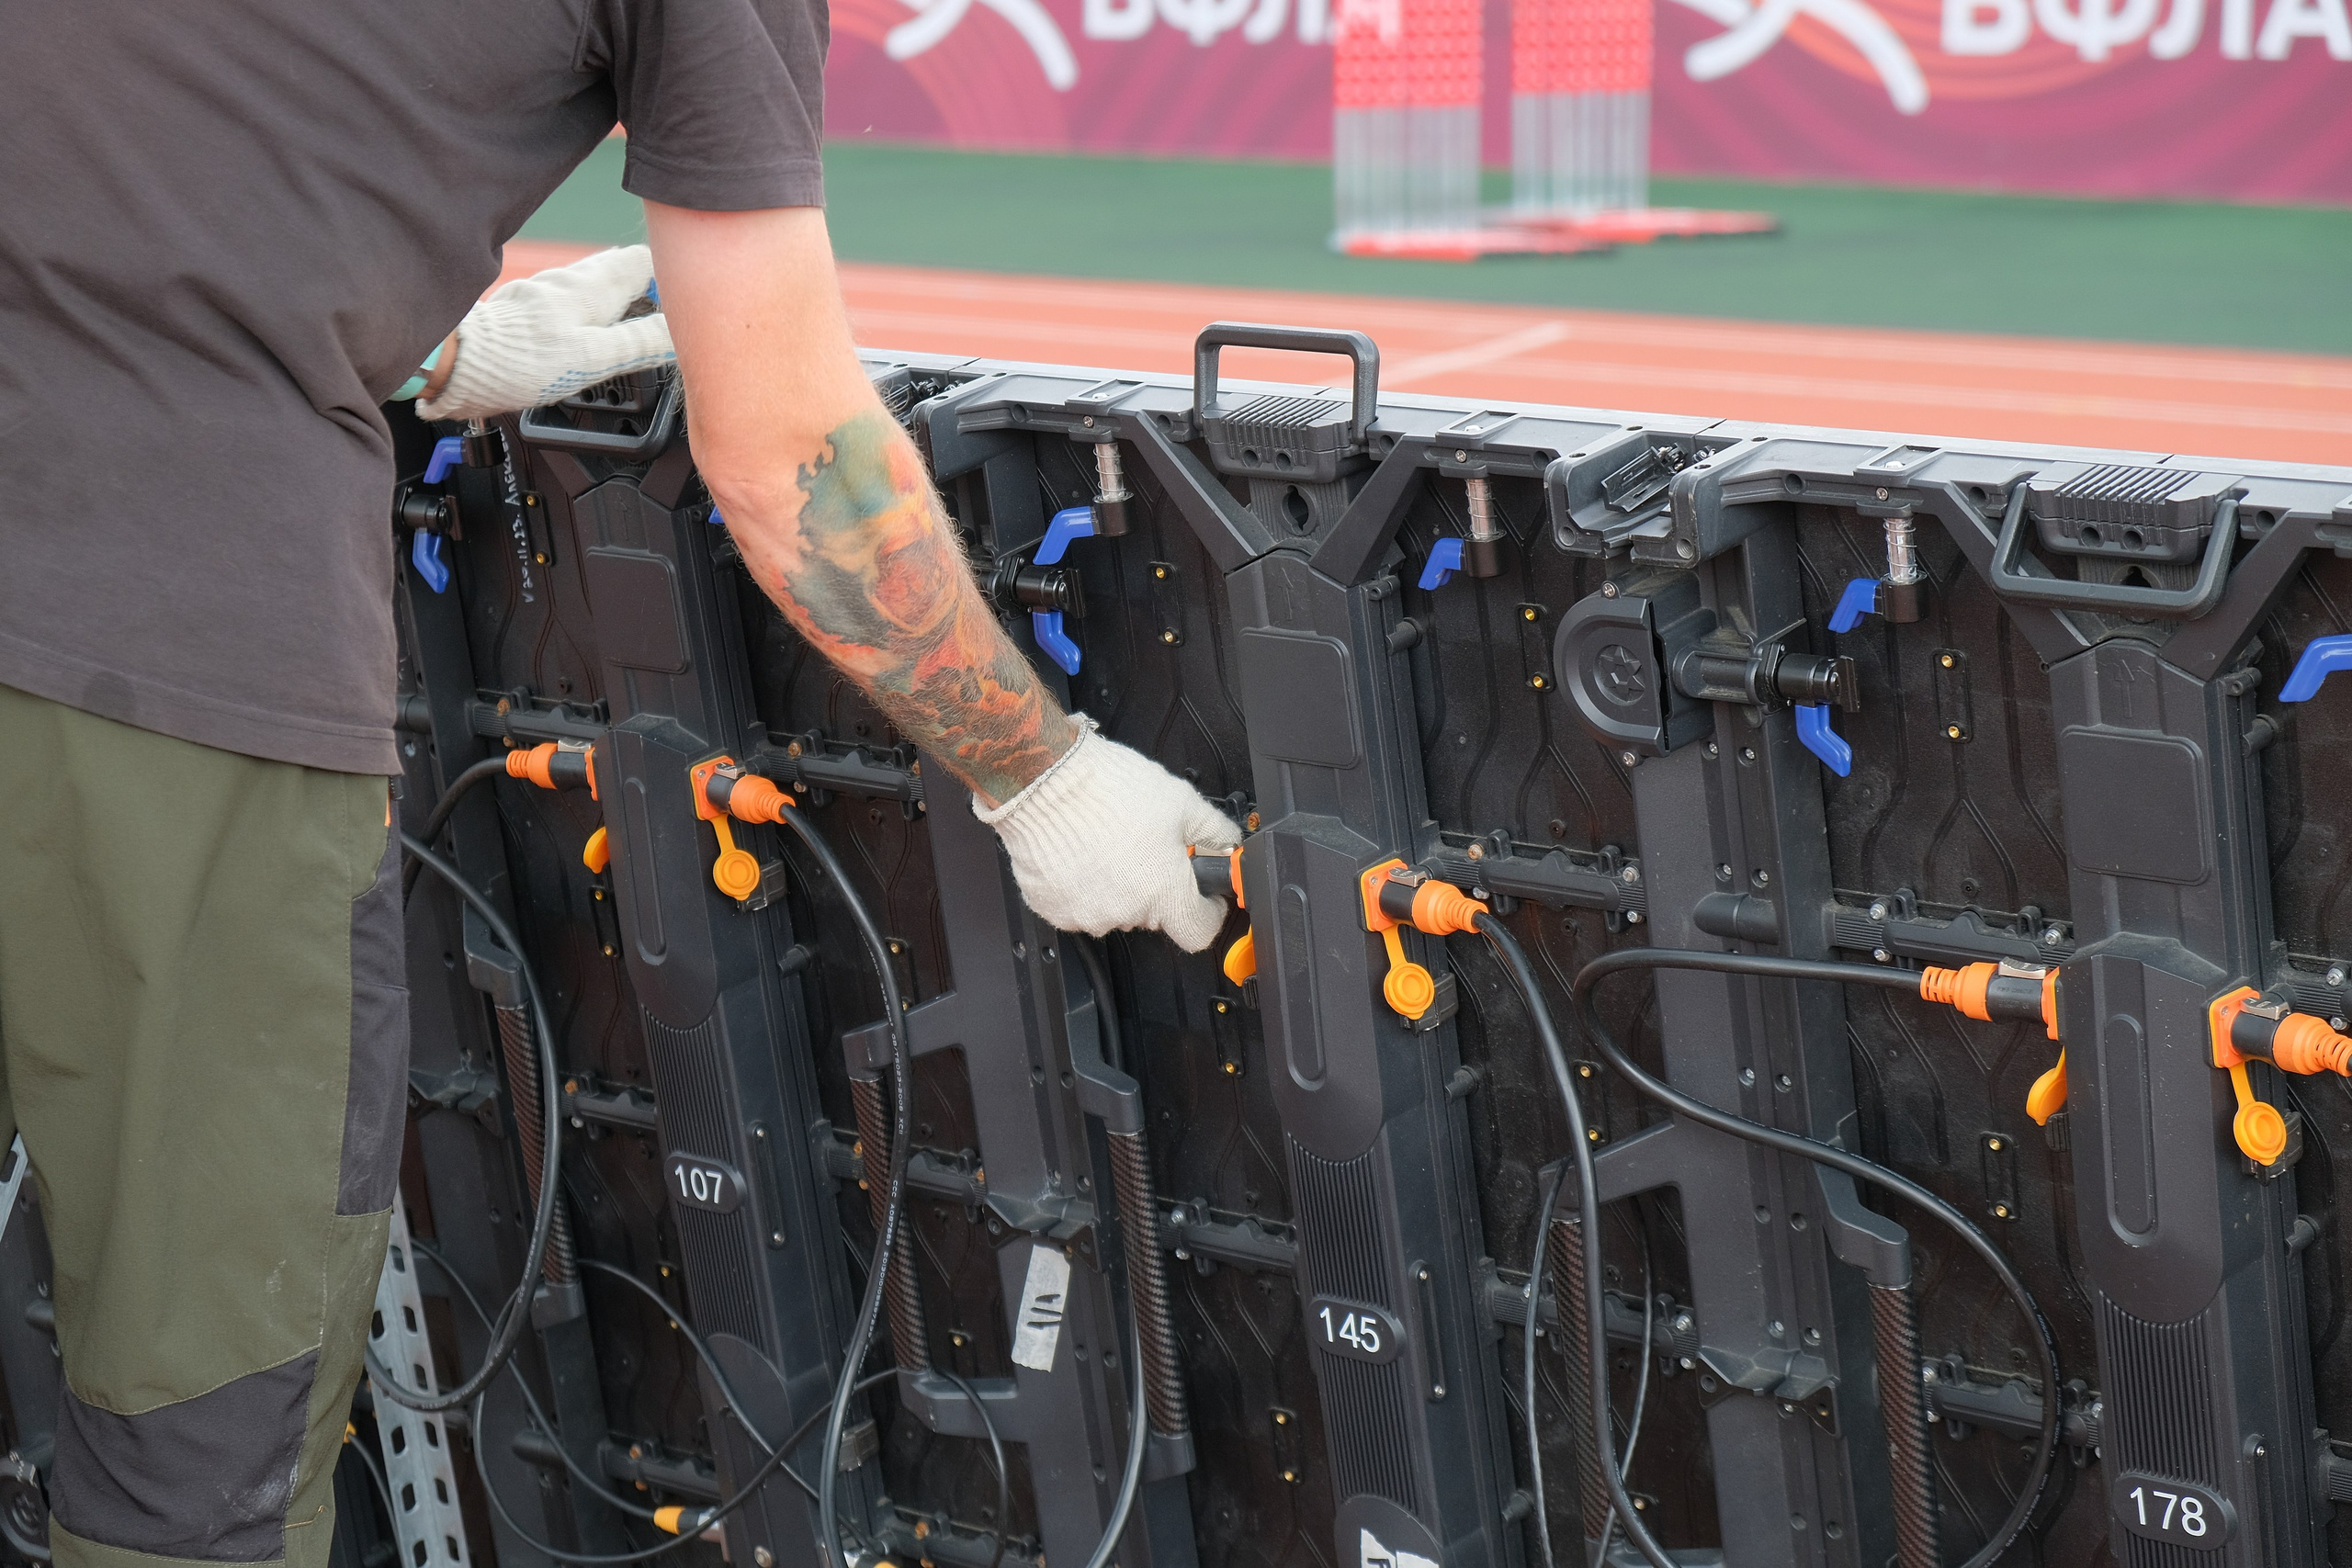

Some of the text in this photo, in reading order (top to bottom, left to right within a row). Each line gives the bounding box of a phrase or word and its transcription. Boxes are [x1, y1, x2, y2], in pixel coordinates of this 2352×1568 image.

[674, 1164, 722, 1204] 107
[1319, 1306, 1380, 1353] 145
[2130, 1486, 2207, 1537] 178
